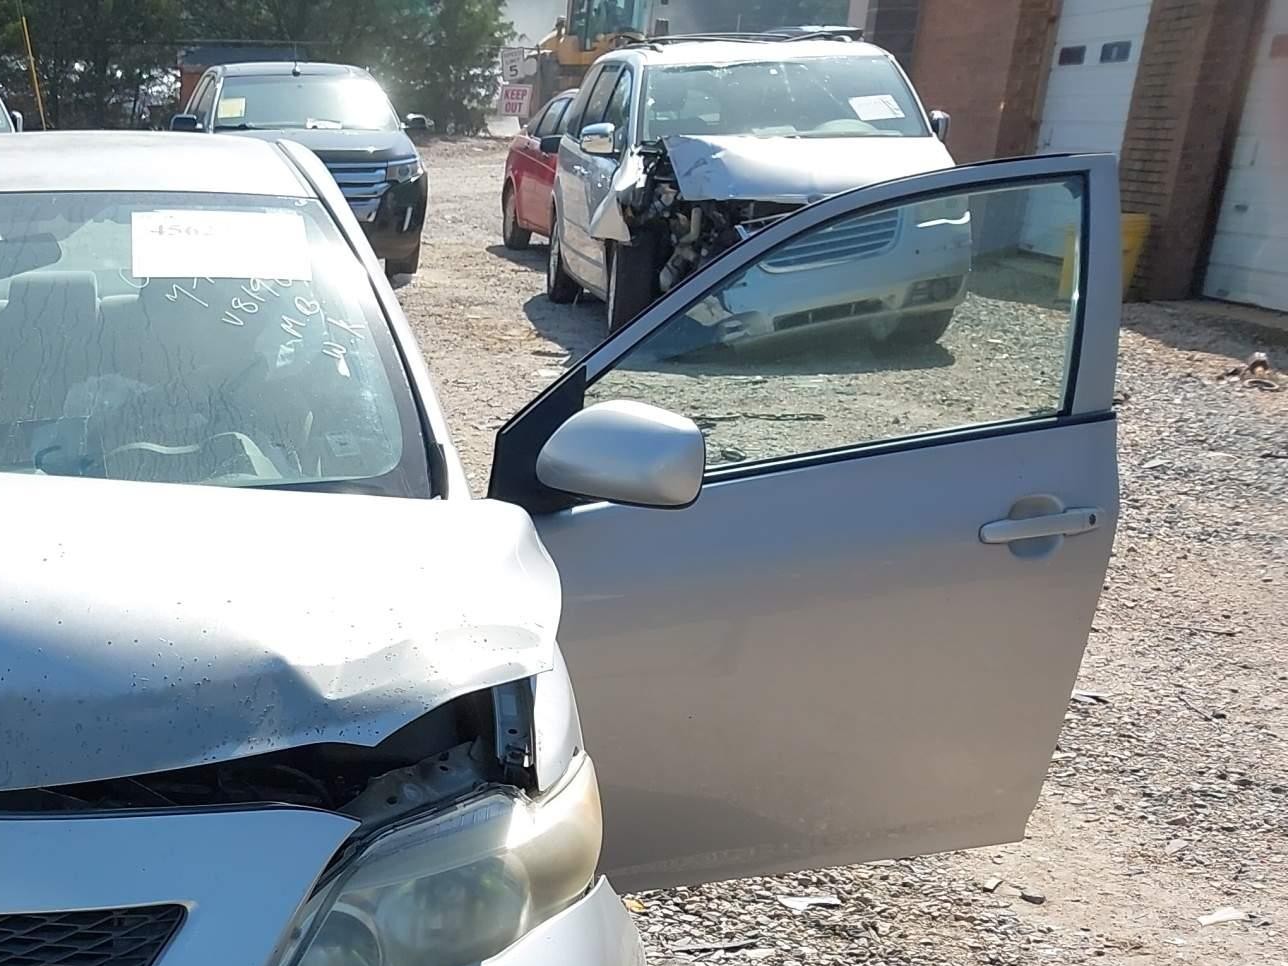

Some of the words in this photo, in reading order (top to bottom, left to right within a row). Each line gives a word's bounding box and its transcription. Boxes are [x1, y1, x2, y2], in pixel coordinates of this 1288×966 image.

[509, 65, 519, 77] 5
[503, 88, 528, 101] KEEP
[504, 102, 524, 113] OUT
